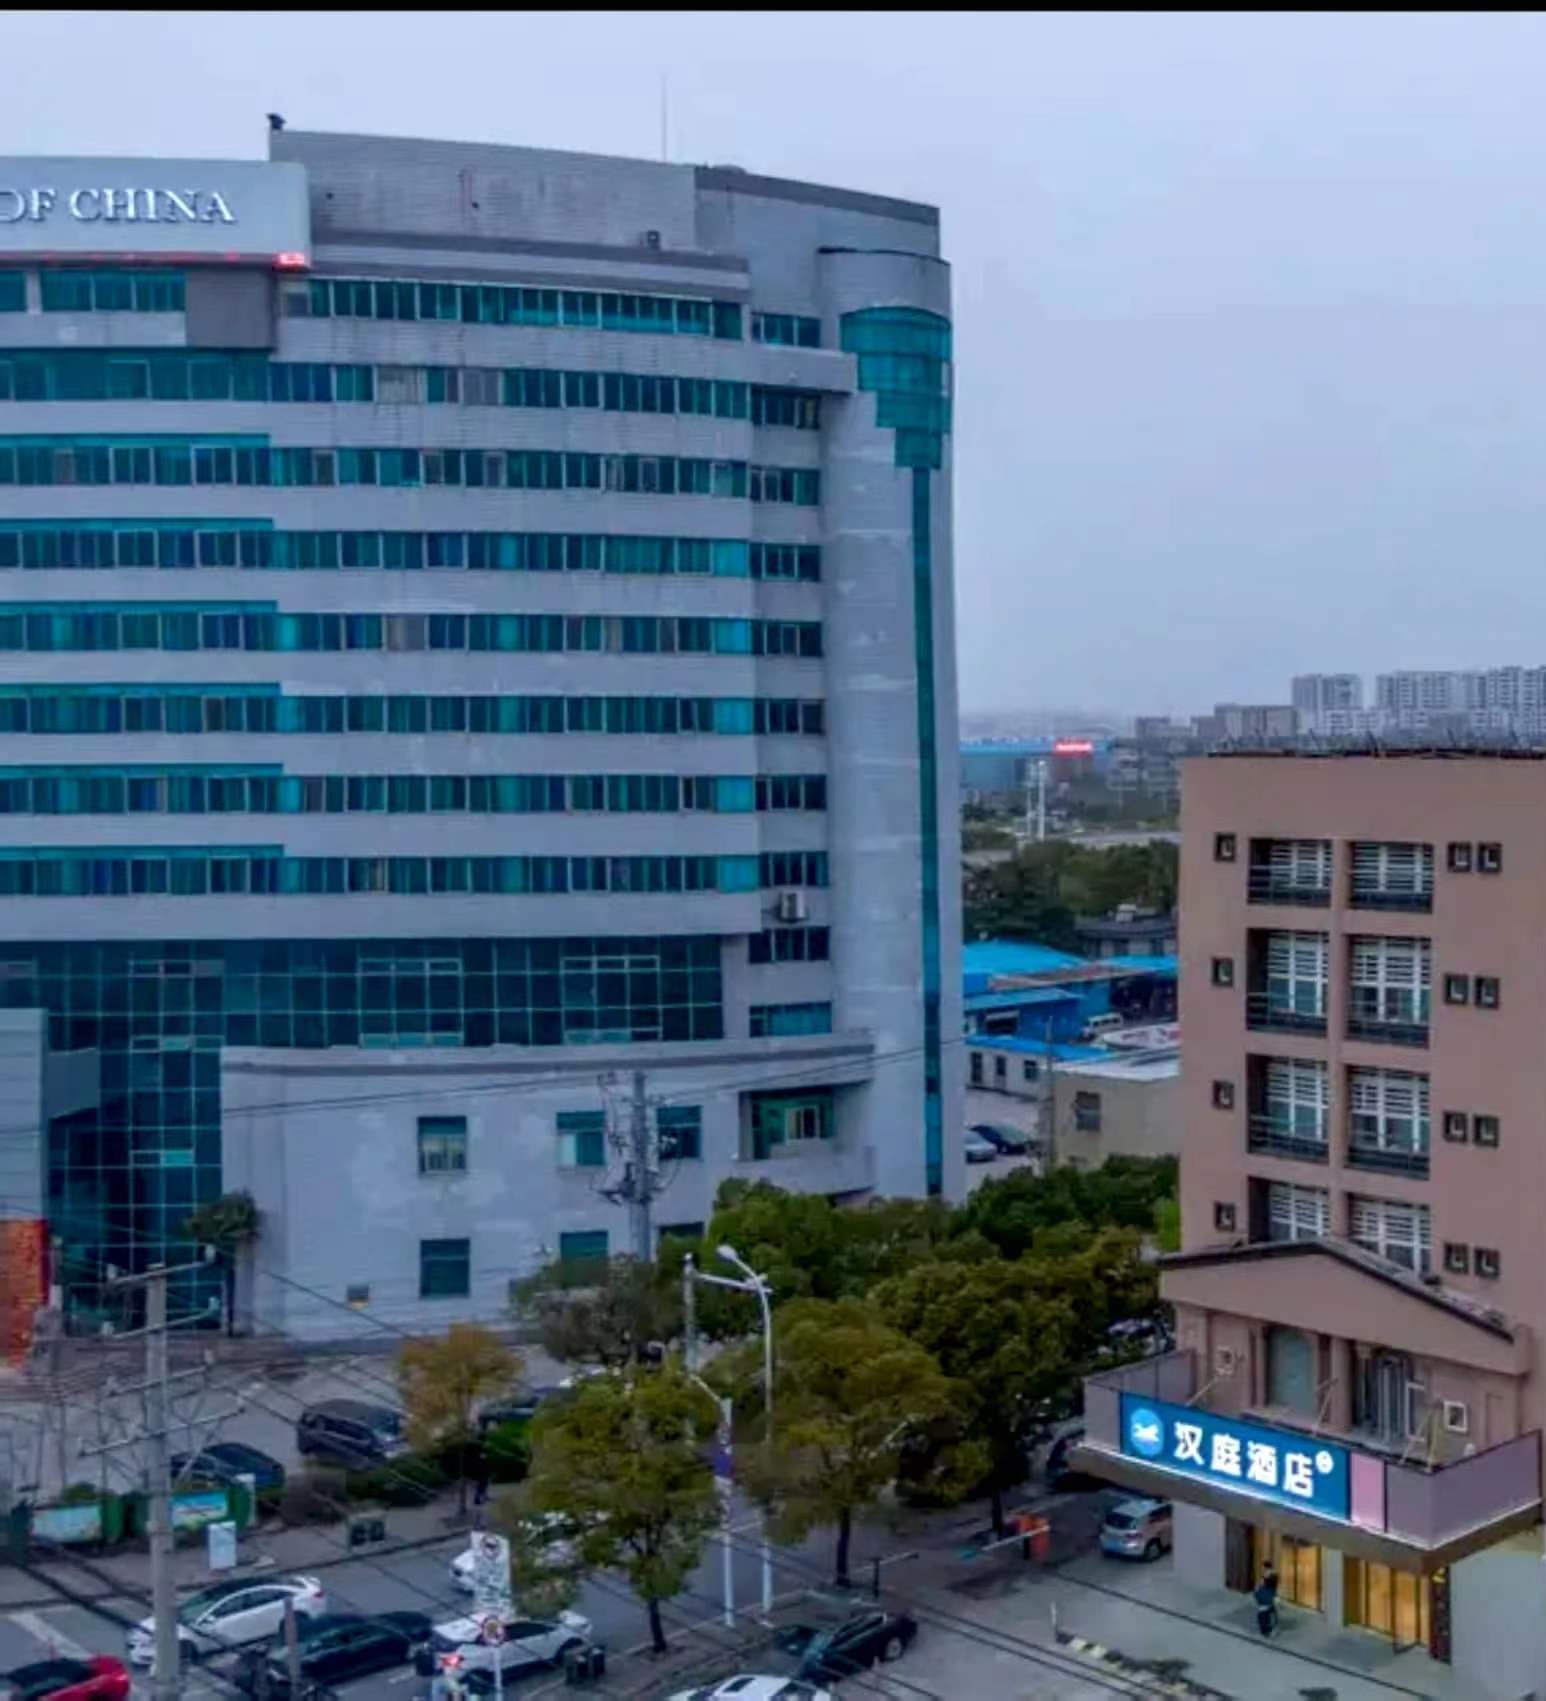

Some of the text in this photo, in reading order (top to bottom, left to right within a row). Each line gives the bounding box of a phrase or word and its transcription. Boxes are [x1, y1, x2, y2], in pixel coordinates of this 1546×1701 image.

[70, 188, 236, 223] CHINA
[1174, 1421, 1313, 1497] 汉庭酒店
